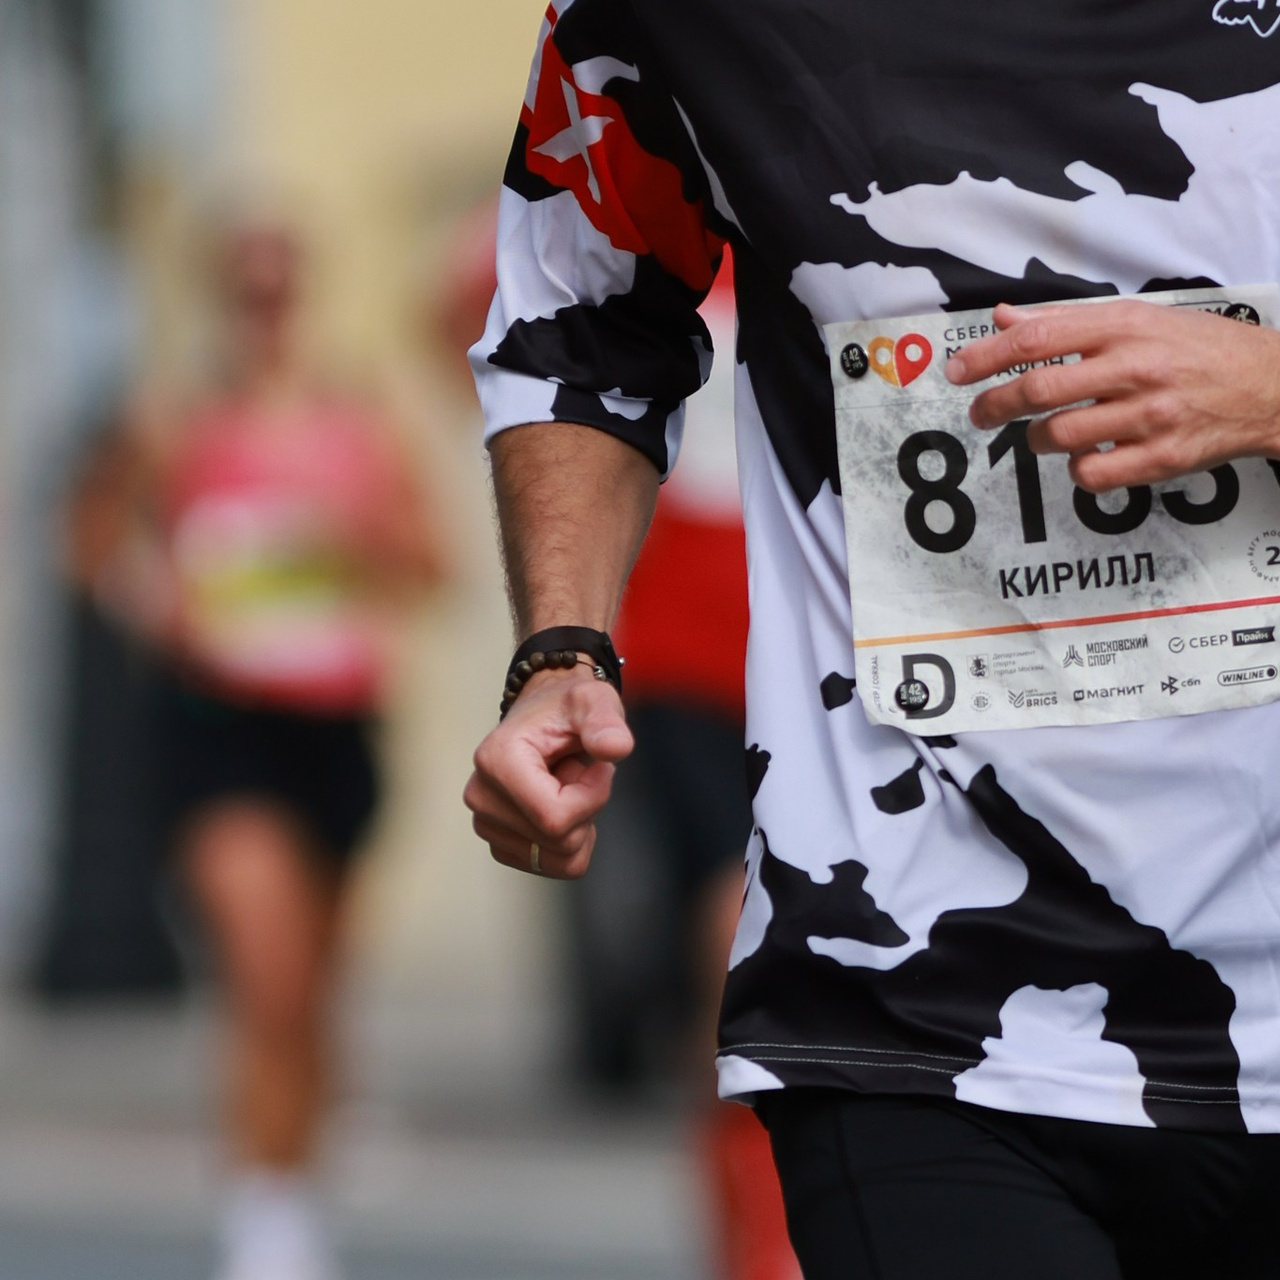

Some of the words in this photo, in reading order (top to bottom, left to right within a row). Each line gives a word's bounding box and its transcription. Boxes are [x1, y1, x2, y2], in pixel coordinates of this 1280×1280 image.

[849, 347, 860, 361] 42
[1000, 552, 1156, 599] КИРИЛЛ
[1086, 634, 1148, 655] МОСКОВСКИЙ
[1189, 634, 1228, 649] СБЕР
[1087, 652, 1117, 668] СПОРТ
[1222, 669, 1264, 683] WINLINE
[901, 653, 956, 719] D
[909, 682, 922, 696] 42
[1026, 696, 1058, 708] BRICS
